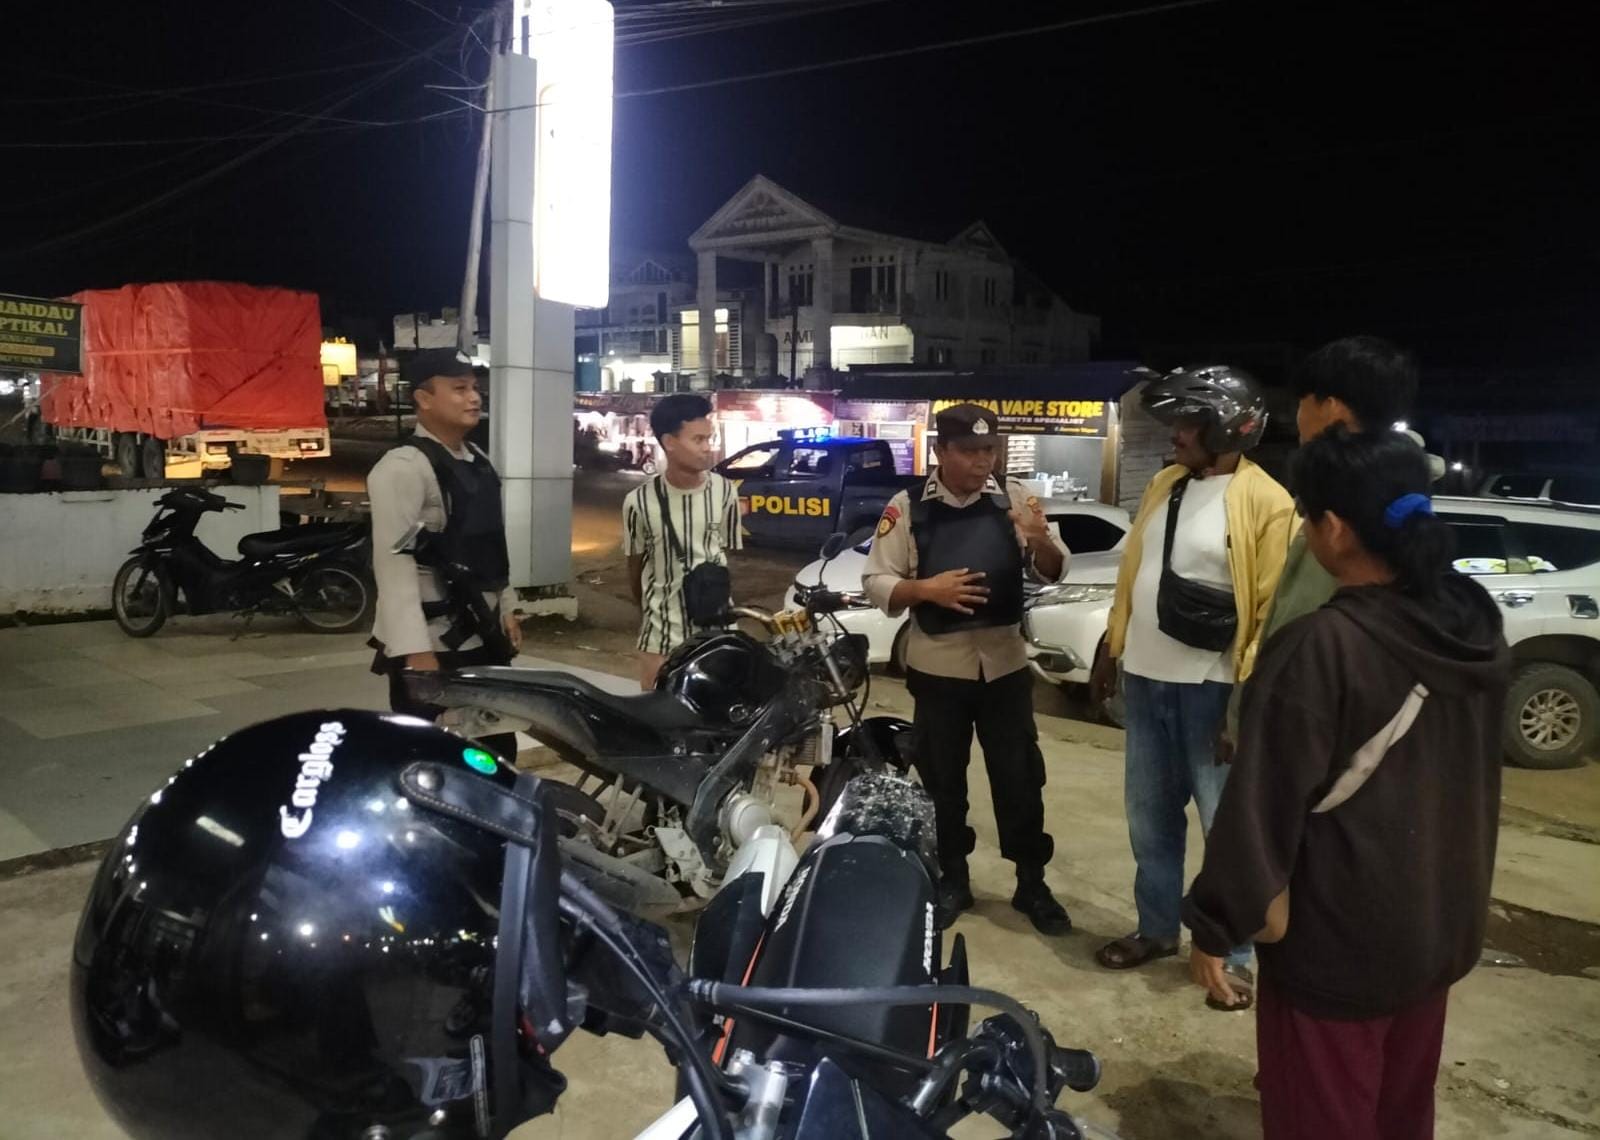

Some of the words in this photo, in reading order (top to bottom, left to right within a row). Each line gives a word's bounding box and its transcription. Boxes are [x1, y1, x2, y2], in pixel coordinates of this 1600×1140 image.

[0, 300, 75, 320] ANDAU
[0, 317, 68, 336] PTIKAL
[1002, 400, 1044, 416] VAPE
[1046, 401, 1104, 417] STORE
[751, 495, 830, 517] POLISI
[279, 721, 347, 839] Cargloss
